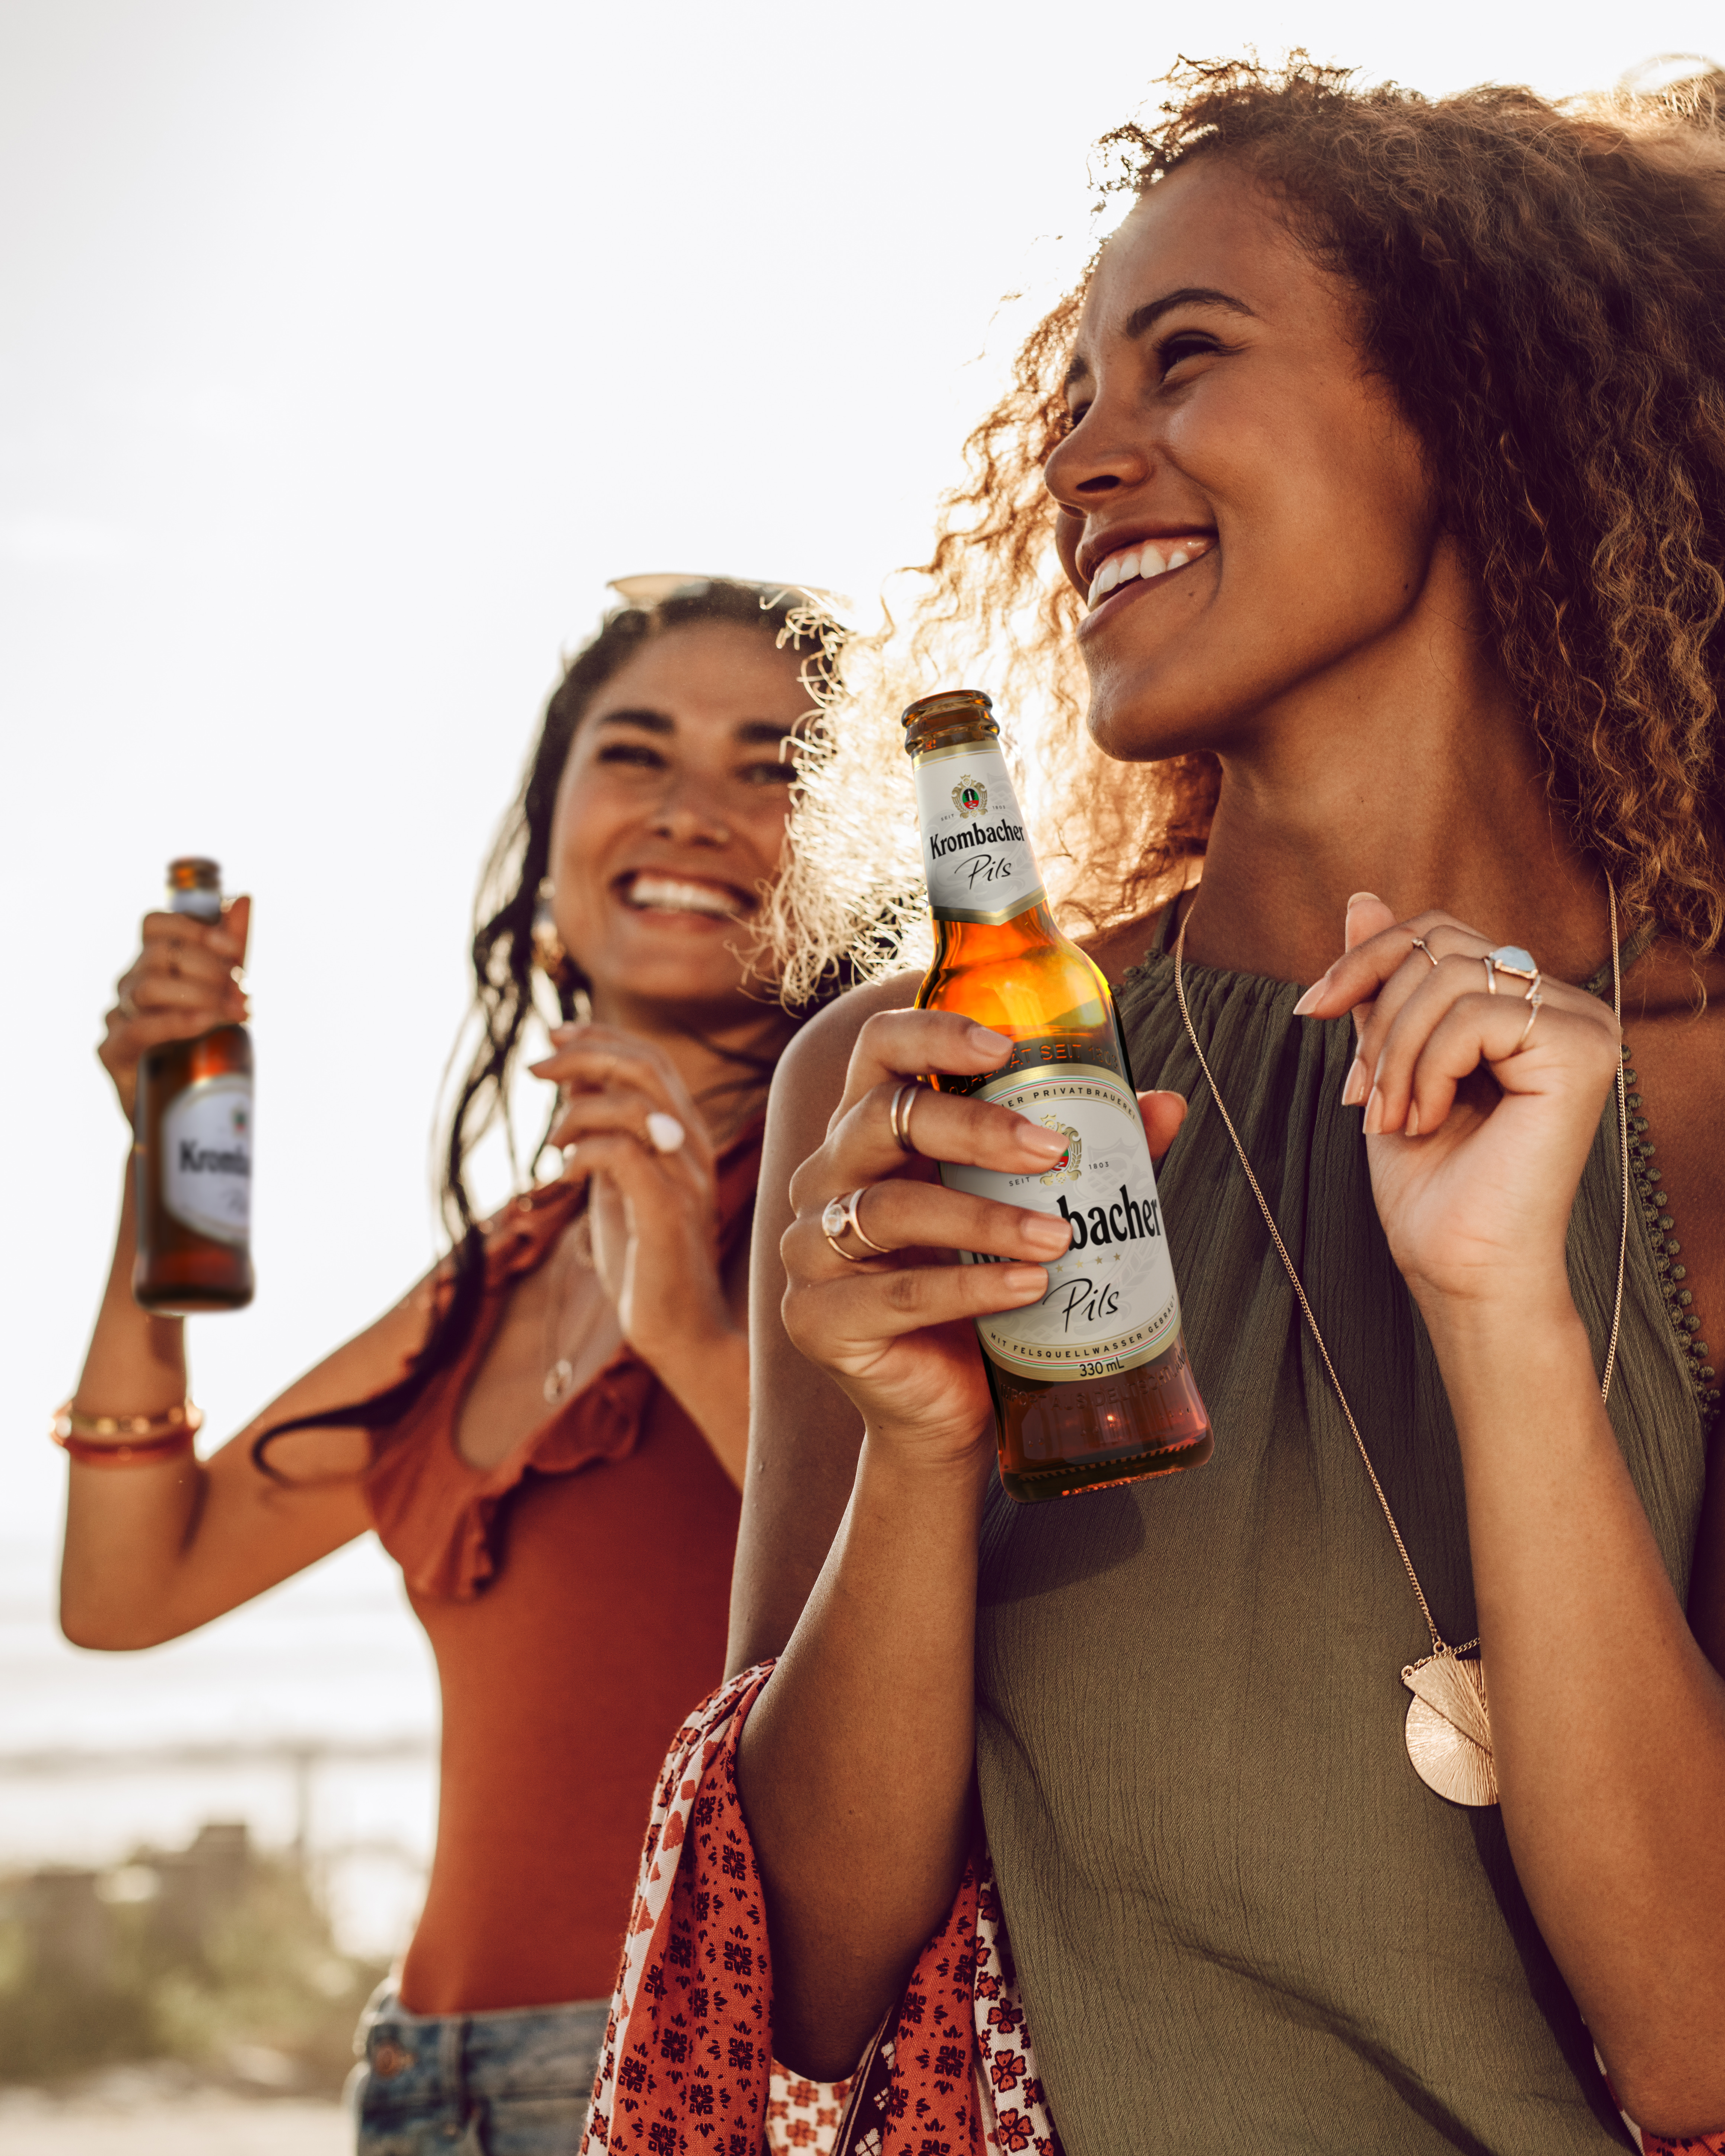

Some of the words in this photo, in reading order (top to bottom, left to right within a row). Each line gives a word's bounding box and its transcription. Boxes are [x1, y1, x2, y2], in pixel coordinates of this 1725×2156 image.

[930, 819, 1025, 860] Krombacher
[954, 854, 1011, 890] Pils
[1040, 1044, 1081, 1060] SEIT
[1033, 1087, 1135, 1119] PRIVATBRAUEREI
[1009, 1177, 1030, 1187] SEIT
[1089, 1161, 1109, 1170] 1803
[1042, 1278, 1119, 1333] Pils
[991, 1332, 1007, 1347] MIT
[1013, 1333, 1142, 1358] FELSQUELLWASSER
[1148, 1295, 1175, 1333] GEBRAUT
[1079, 1361, 1104, 1377] 330
[1106, 1357, 1124, 1372] mL
